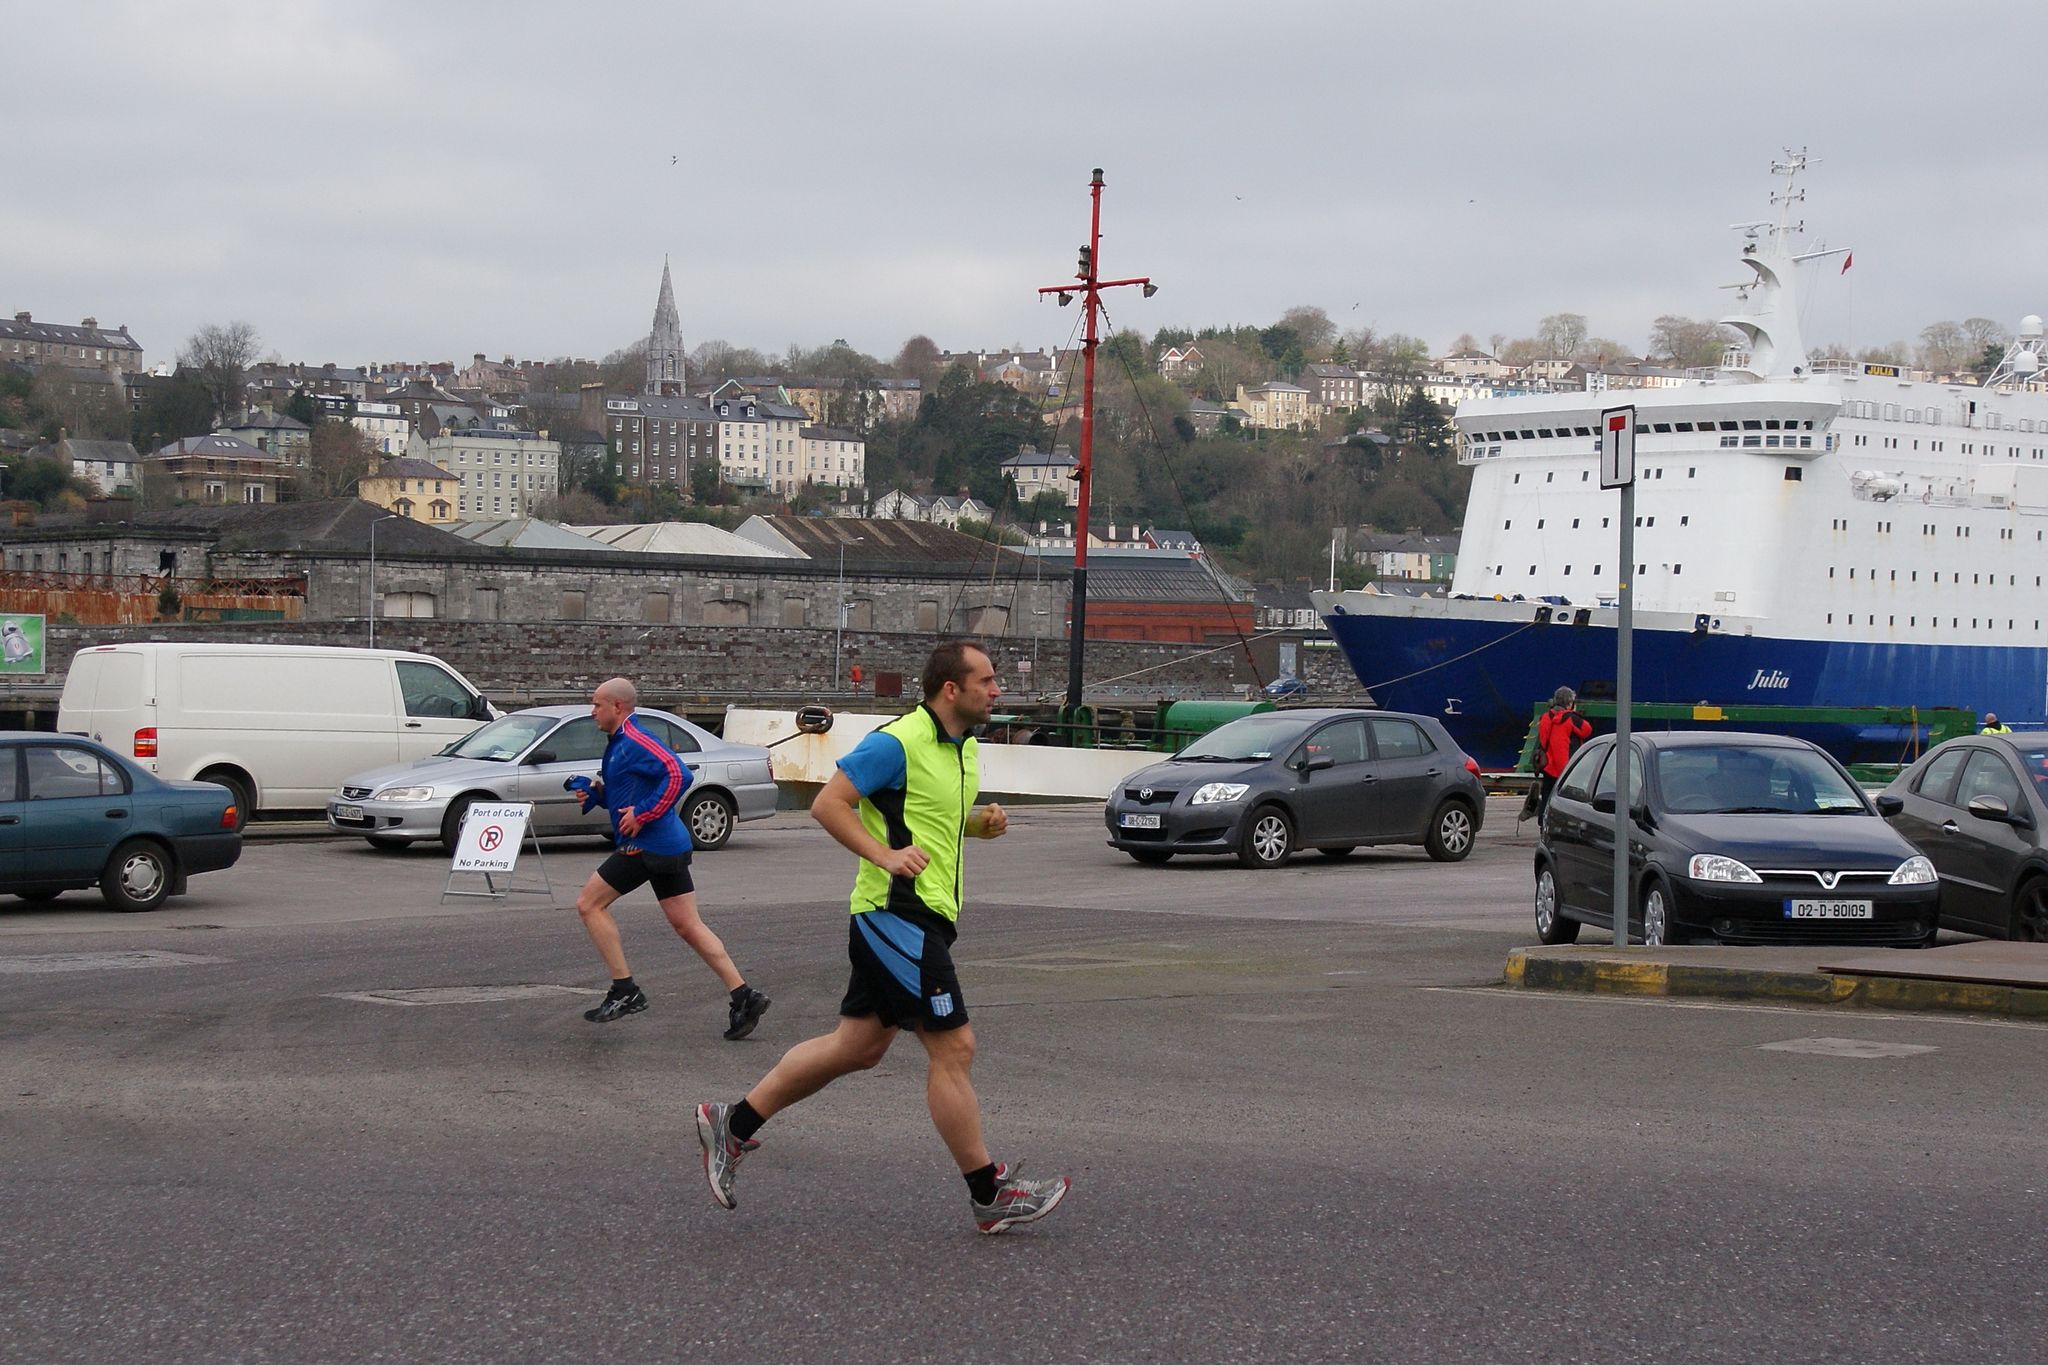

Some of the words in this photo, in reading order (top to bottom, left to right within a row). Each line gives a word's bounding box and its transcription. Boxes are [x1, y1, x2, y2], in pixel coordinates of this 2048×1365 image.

[1867, 365, 1894, 377] JULIA
[1747, 669, 1790, 690] Julia
[472, 808, 490, 817] Port
[493, 808, 502, 817] of
[504, 808, 524, 817] Cork
[459, 859, 472, 867] No
[474, 859, 509, 869] Parking
[1798, 903, 1866, 917] 02-D-80109
